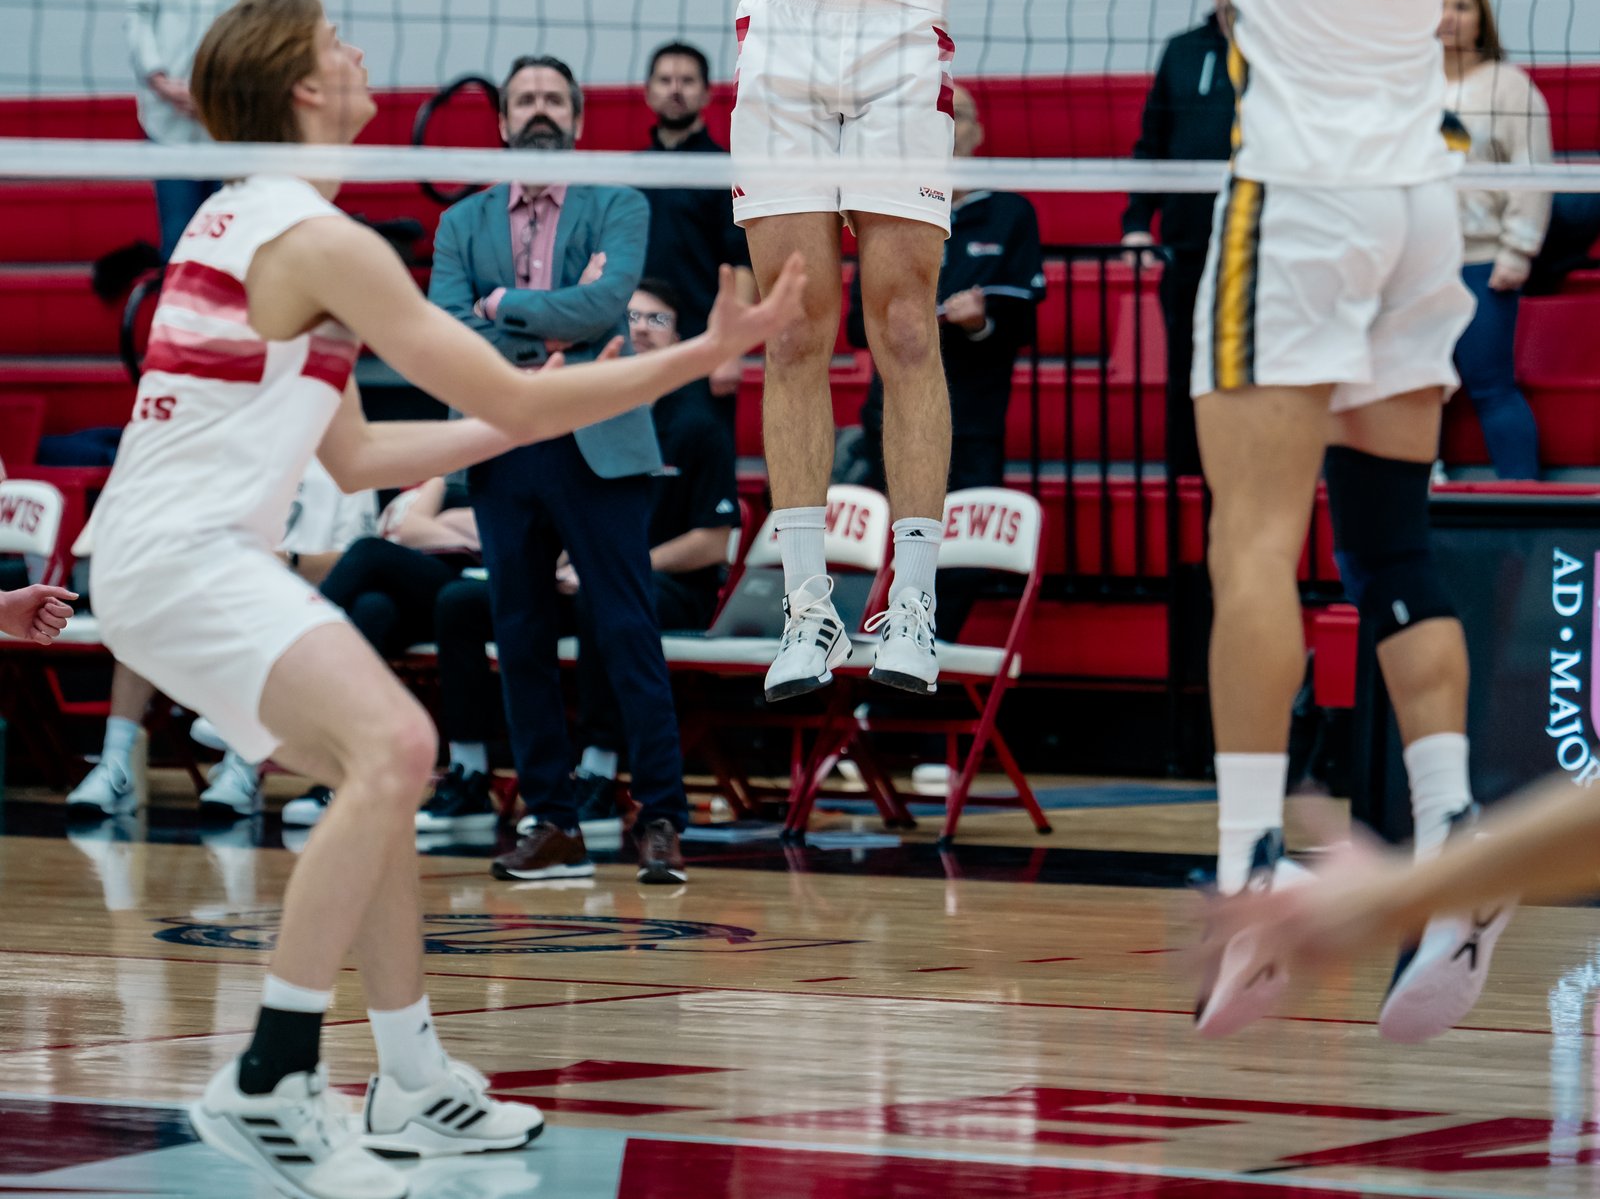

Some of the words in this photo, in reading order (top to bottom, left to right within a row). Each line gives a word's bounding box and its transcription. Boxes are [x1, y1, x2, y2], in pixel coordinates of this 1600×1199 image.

[0, 496, 46, 534] WIS
[825, 501, 872, 542] WIS
[944, 503, 1022, 545] EWIS
[1552, 547, 1584, 617] AD
